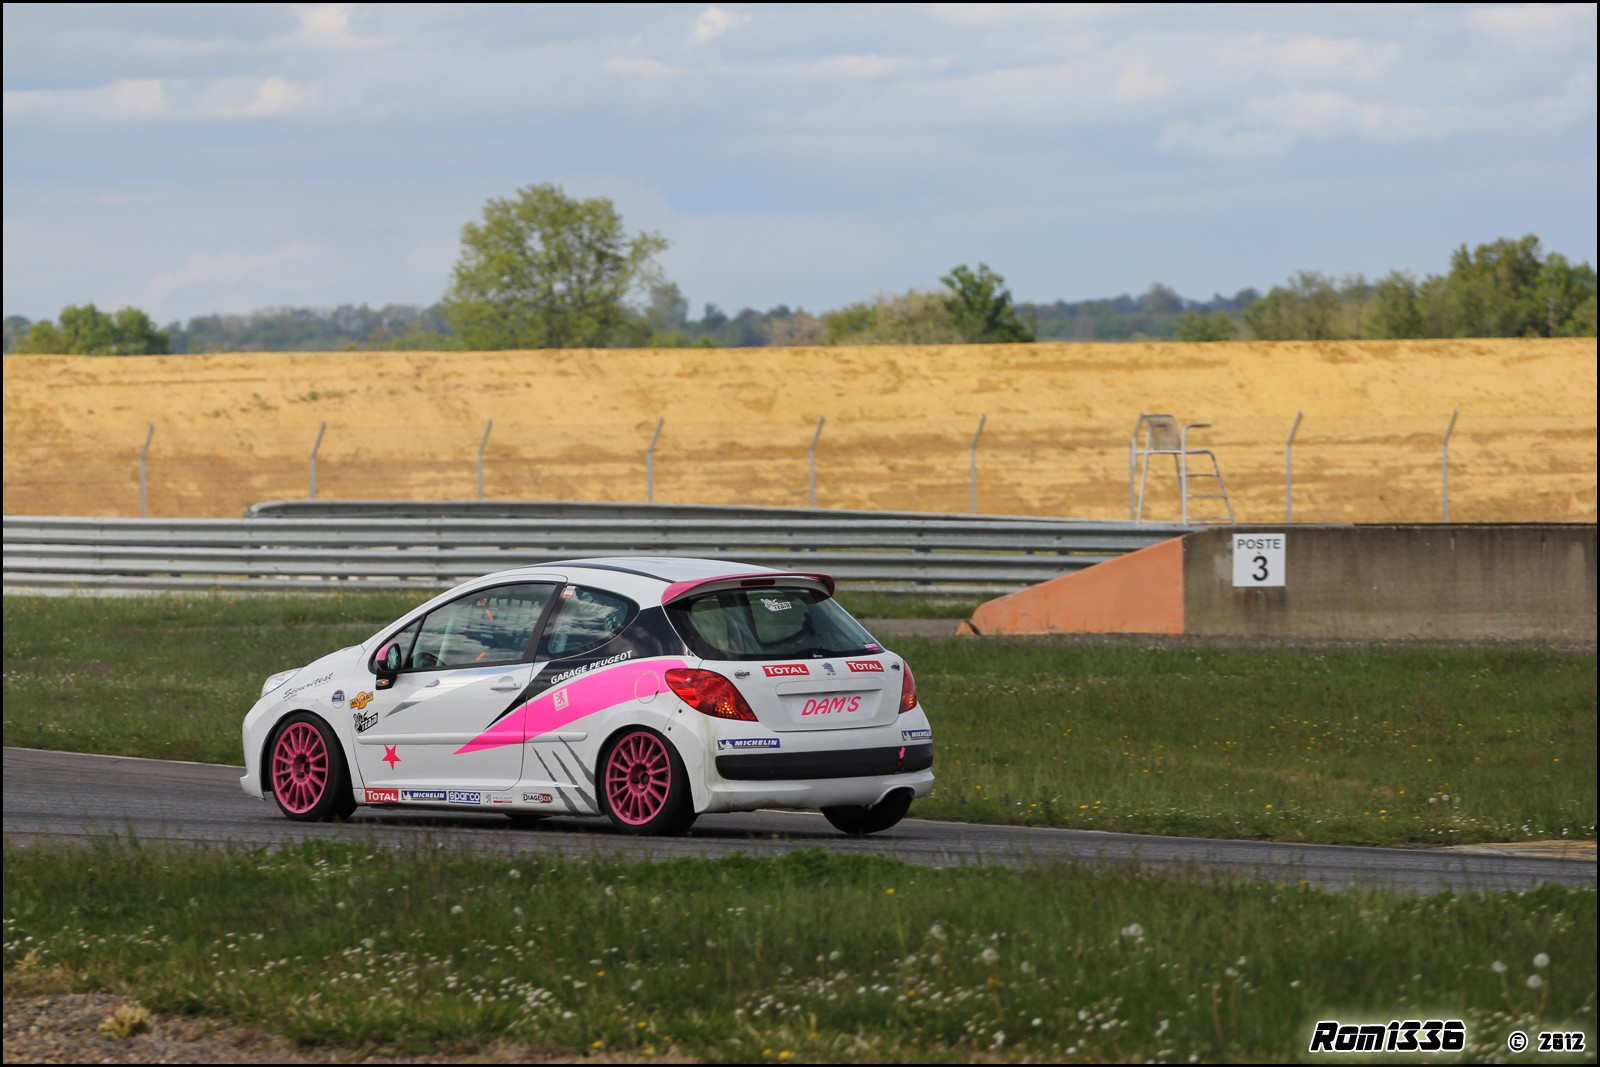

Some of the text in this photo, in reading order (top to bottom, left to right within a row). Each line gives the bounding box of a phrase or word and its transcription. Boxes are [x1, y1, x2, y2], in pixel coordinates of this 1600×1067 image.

[1237, 538, 1281, 549] POSTE
[1252, 555, 1268, 581] 3
[551, 650, 632, 685] GARAGE PEUGEOT
[764, 666, 807, 675] TOTAL
[848, 662, 882, 670] TOTAL
[801, 695, 862, 716] DAM'S
[366, 790, 397, 801] TOTAL
[412, 791, 445, 799] MICHELIN
[449, 792, 480, 801] sparco
